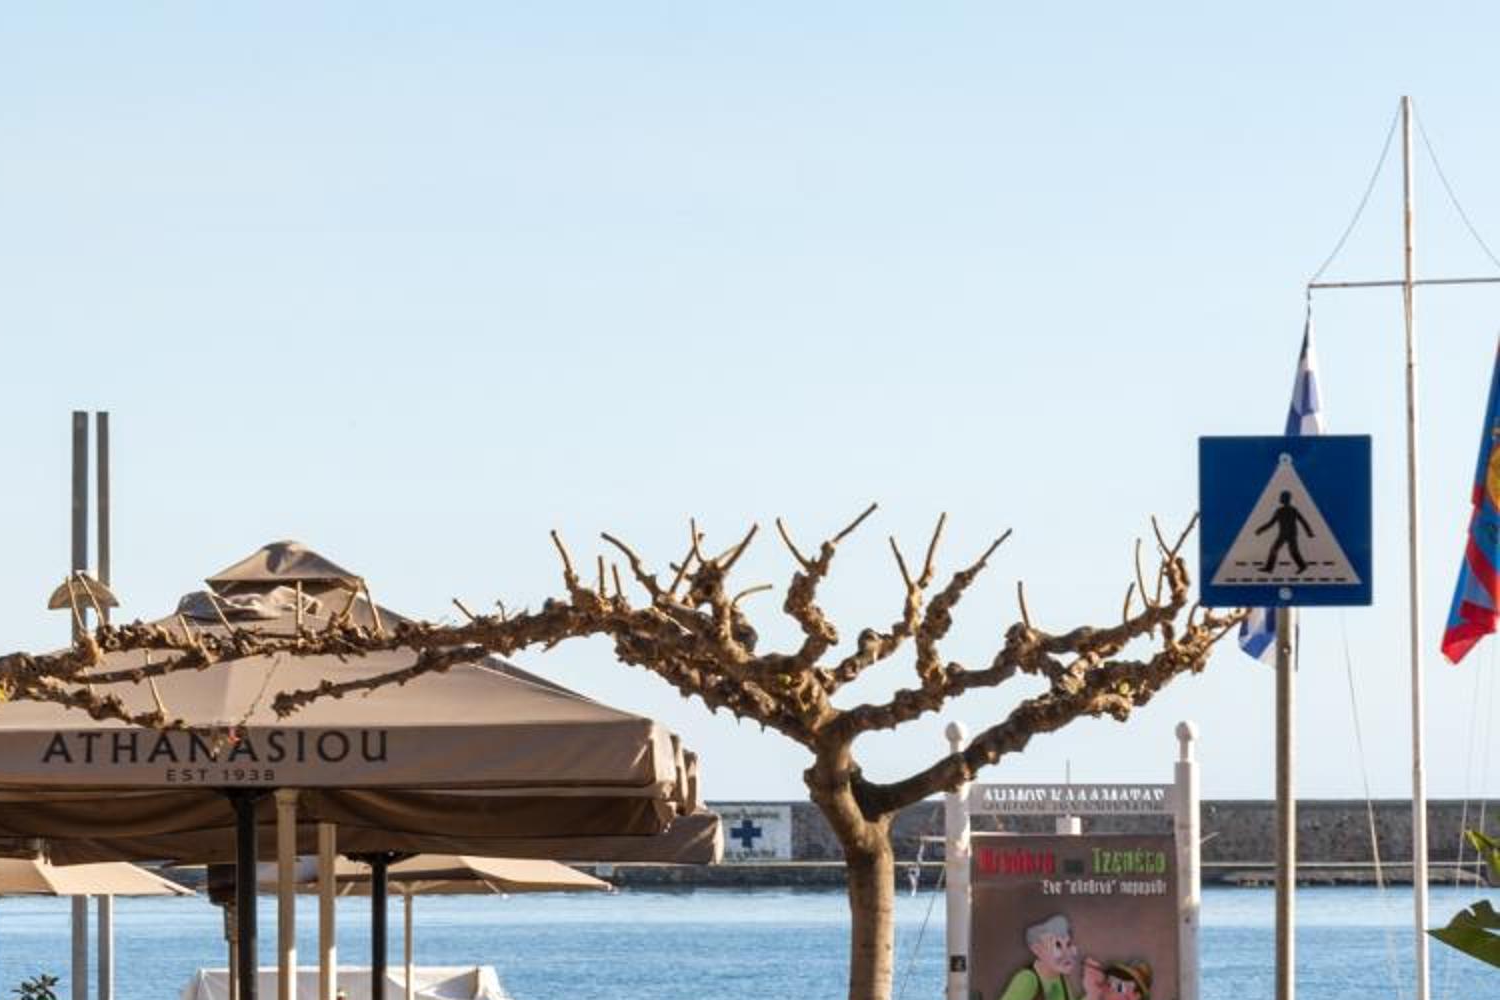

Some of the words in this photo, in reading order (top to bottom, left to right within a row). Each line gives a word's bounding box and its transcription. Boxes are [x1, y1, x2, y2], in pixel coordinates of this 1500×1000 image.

[41, 729, 390, 764] ATHANASIOU
[166, 768, 206, 782] EST
[223, 768, 277, 782] 1938
